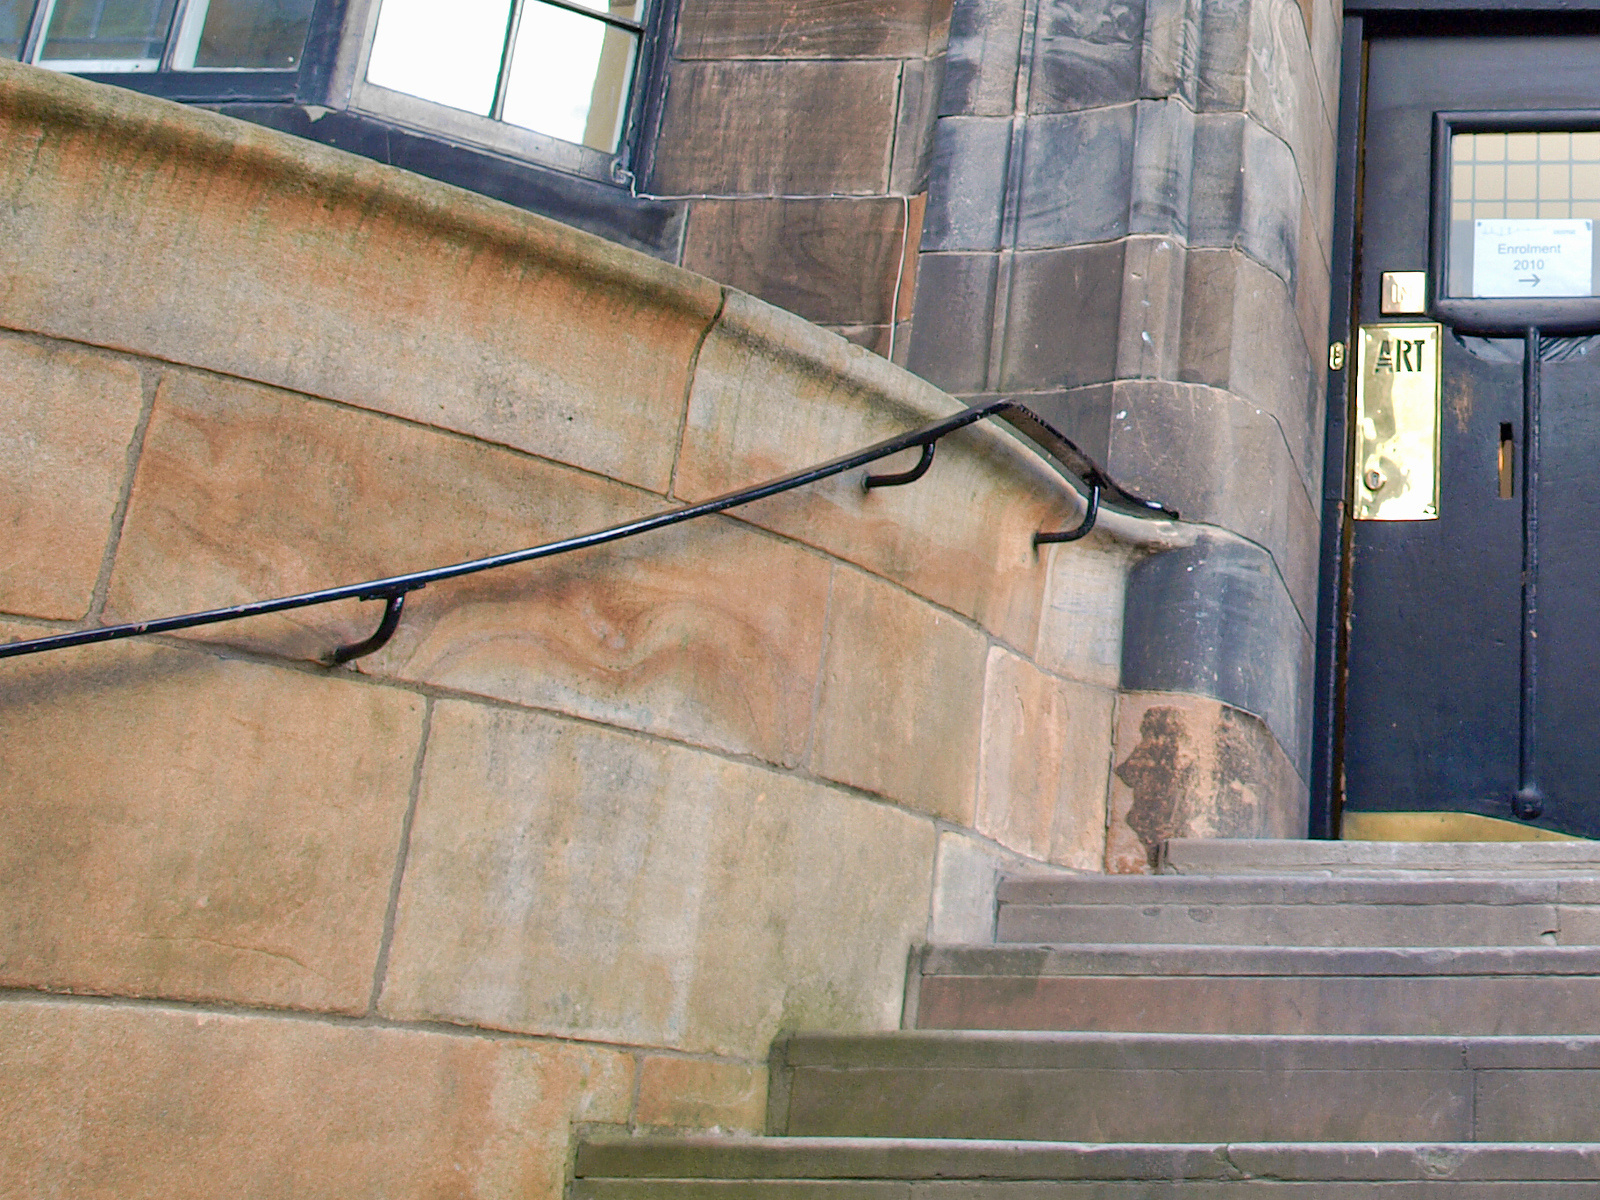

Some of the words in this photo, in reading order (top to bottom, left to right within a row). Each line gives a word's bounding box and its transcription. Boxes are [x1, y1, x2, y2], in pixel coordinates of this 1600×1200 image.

[1497, 243, 1562, 254] Enrolment
[1513, 259, 1545, 271] 2010
[1372, 339, 1426, 375] ART
